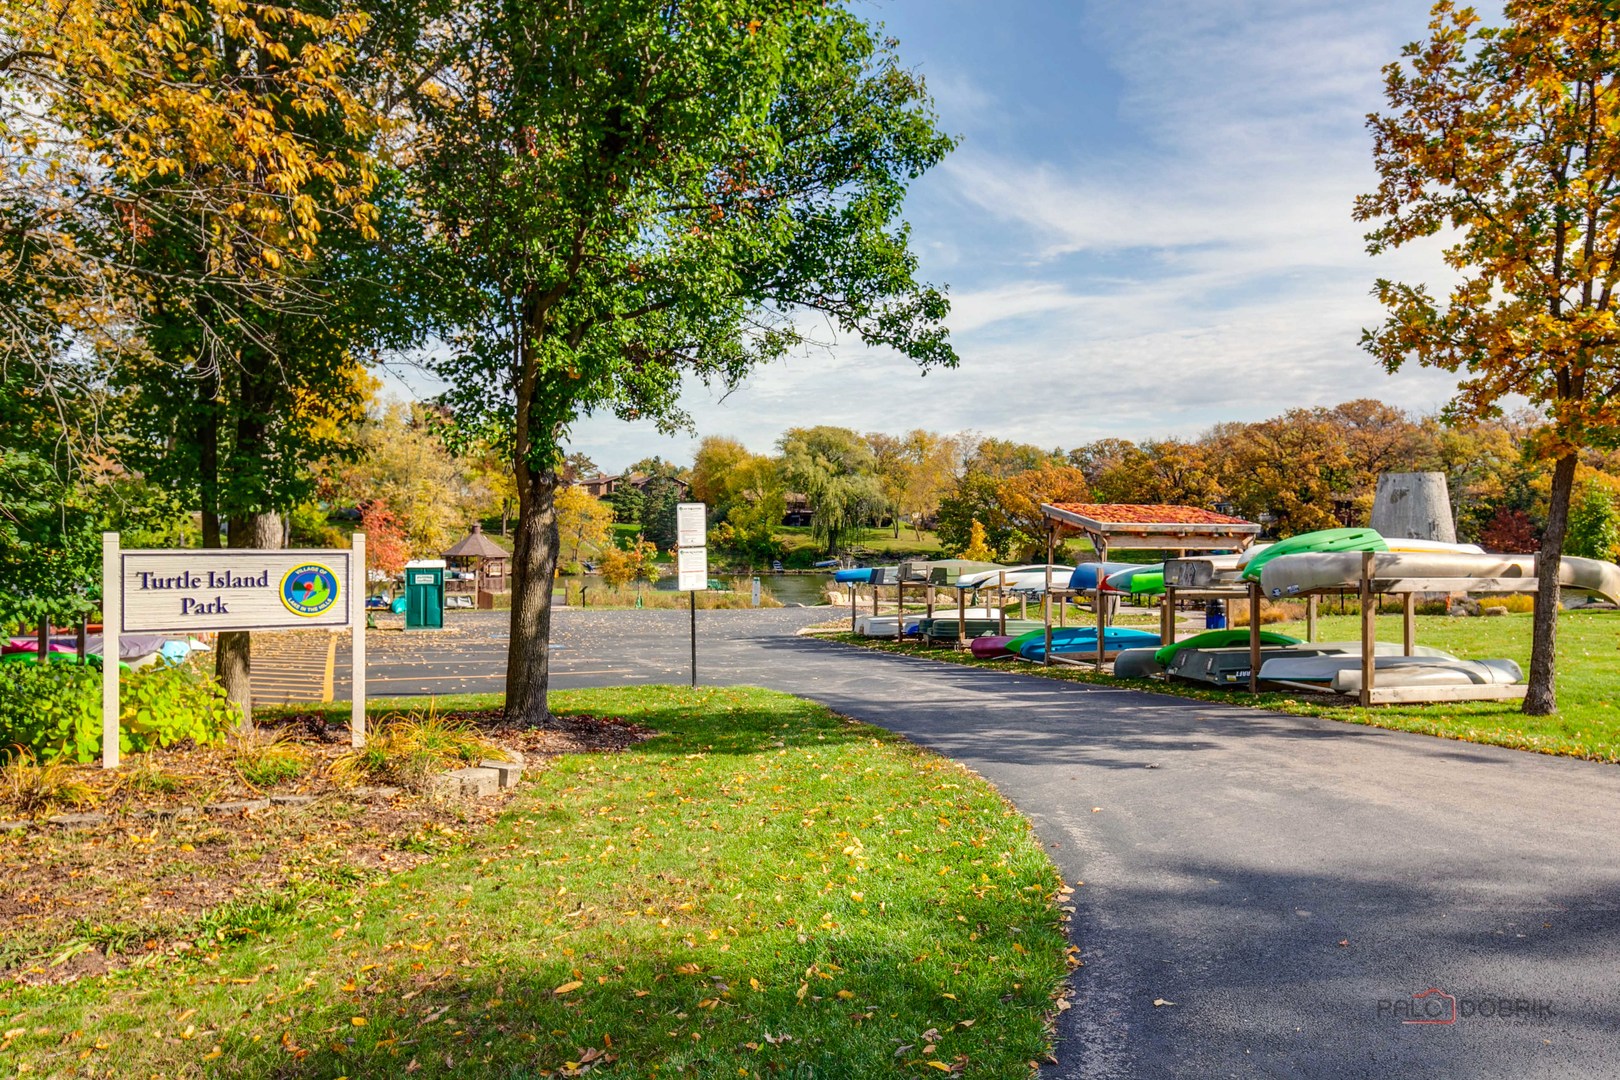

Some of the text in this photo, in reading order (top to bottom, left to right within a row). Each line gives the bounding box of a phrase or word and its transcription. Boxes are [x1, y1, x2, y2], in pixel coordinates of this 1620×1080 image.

[295, 566, 319, 575] VILLAGE
[135, 569, 270, 590] Turtle Island
[179, 595, 230, 616] Park
[287, 597, 301, 610] LAKE
[318, 598, 333, 610] HILLS
